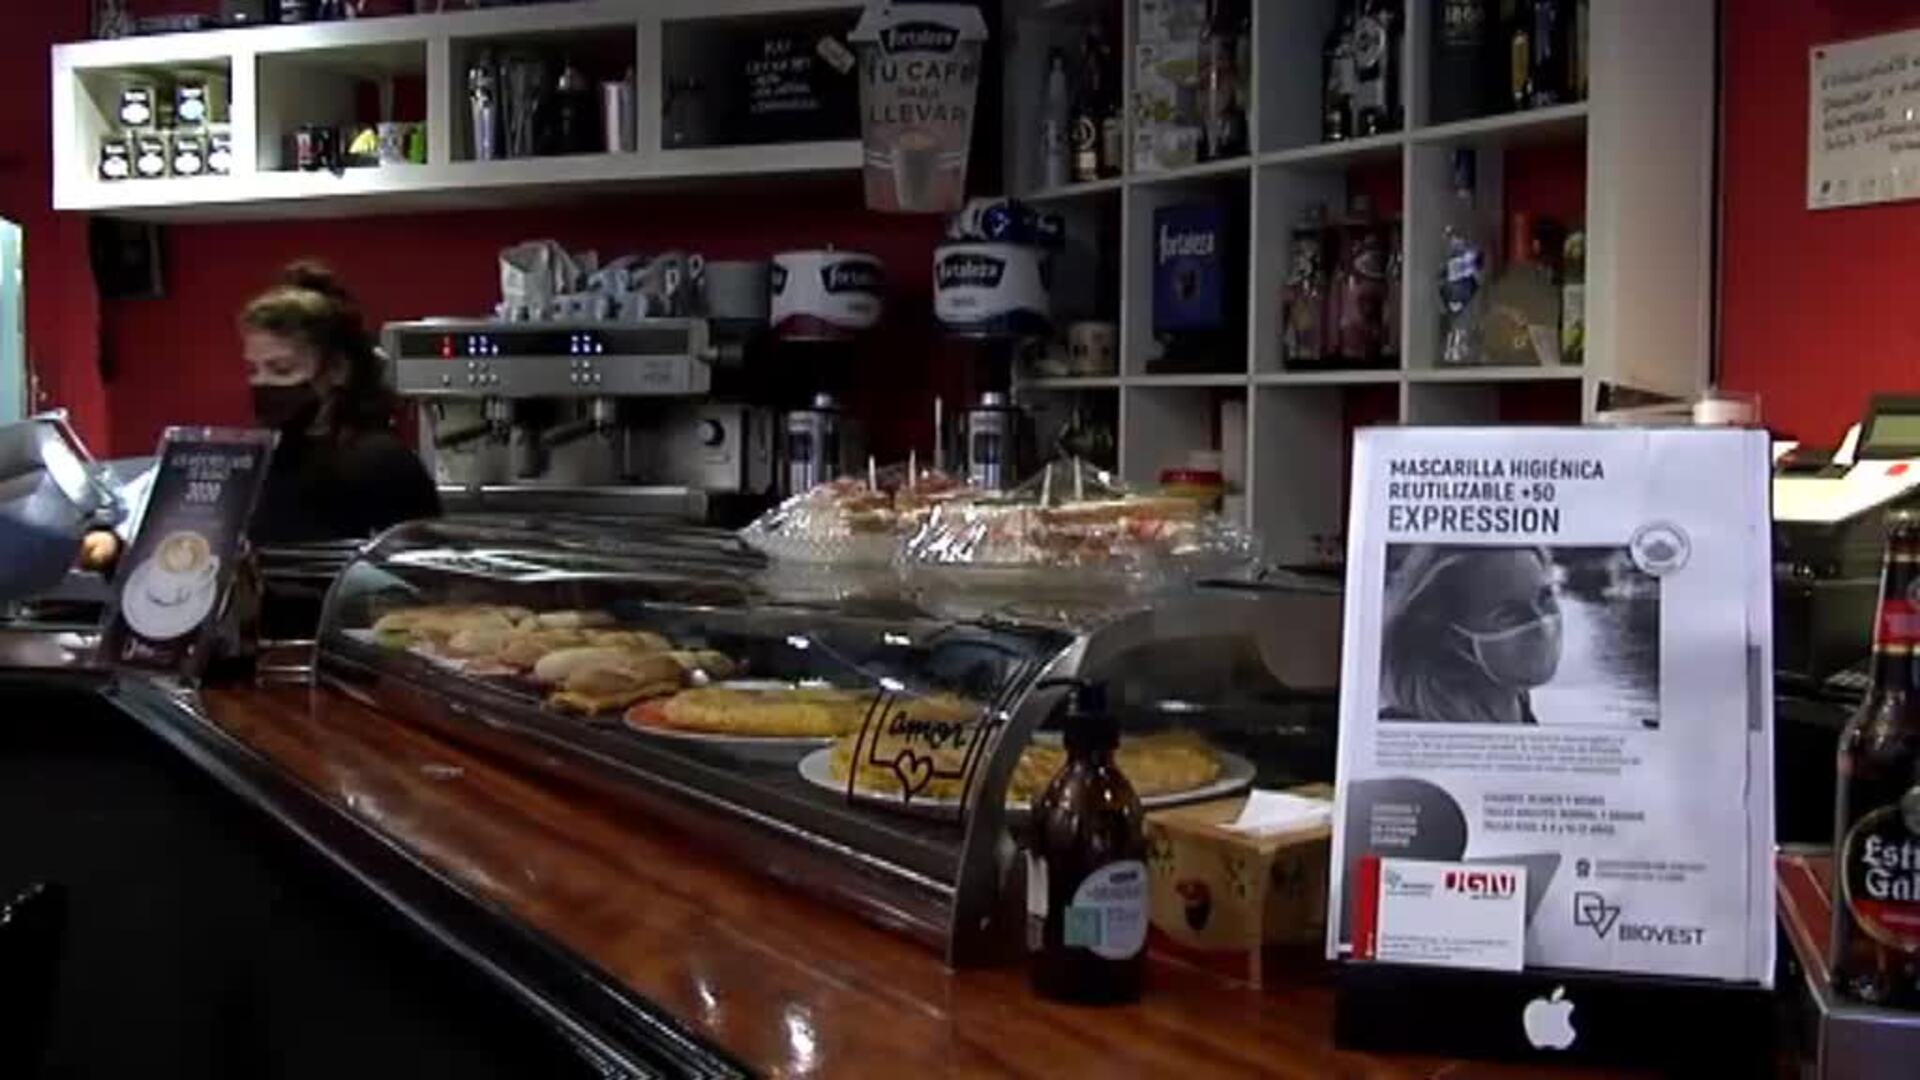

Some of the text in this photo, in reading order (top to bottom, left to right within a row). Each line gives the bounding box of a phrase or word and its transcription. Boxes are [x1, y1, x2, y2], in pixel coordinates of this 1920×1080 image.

[1390, 457, 1605, 480] MASCARILLA HIGIÉNICA
[1388, 481, 1516, 501] REUTILIZABLE
[1387, 505, 1560, 534] EXPRESSION
[1618, 924, 1705, 946] BIOVEST
